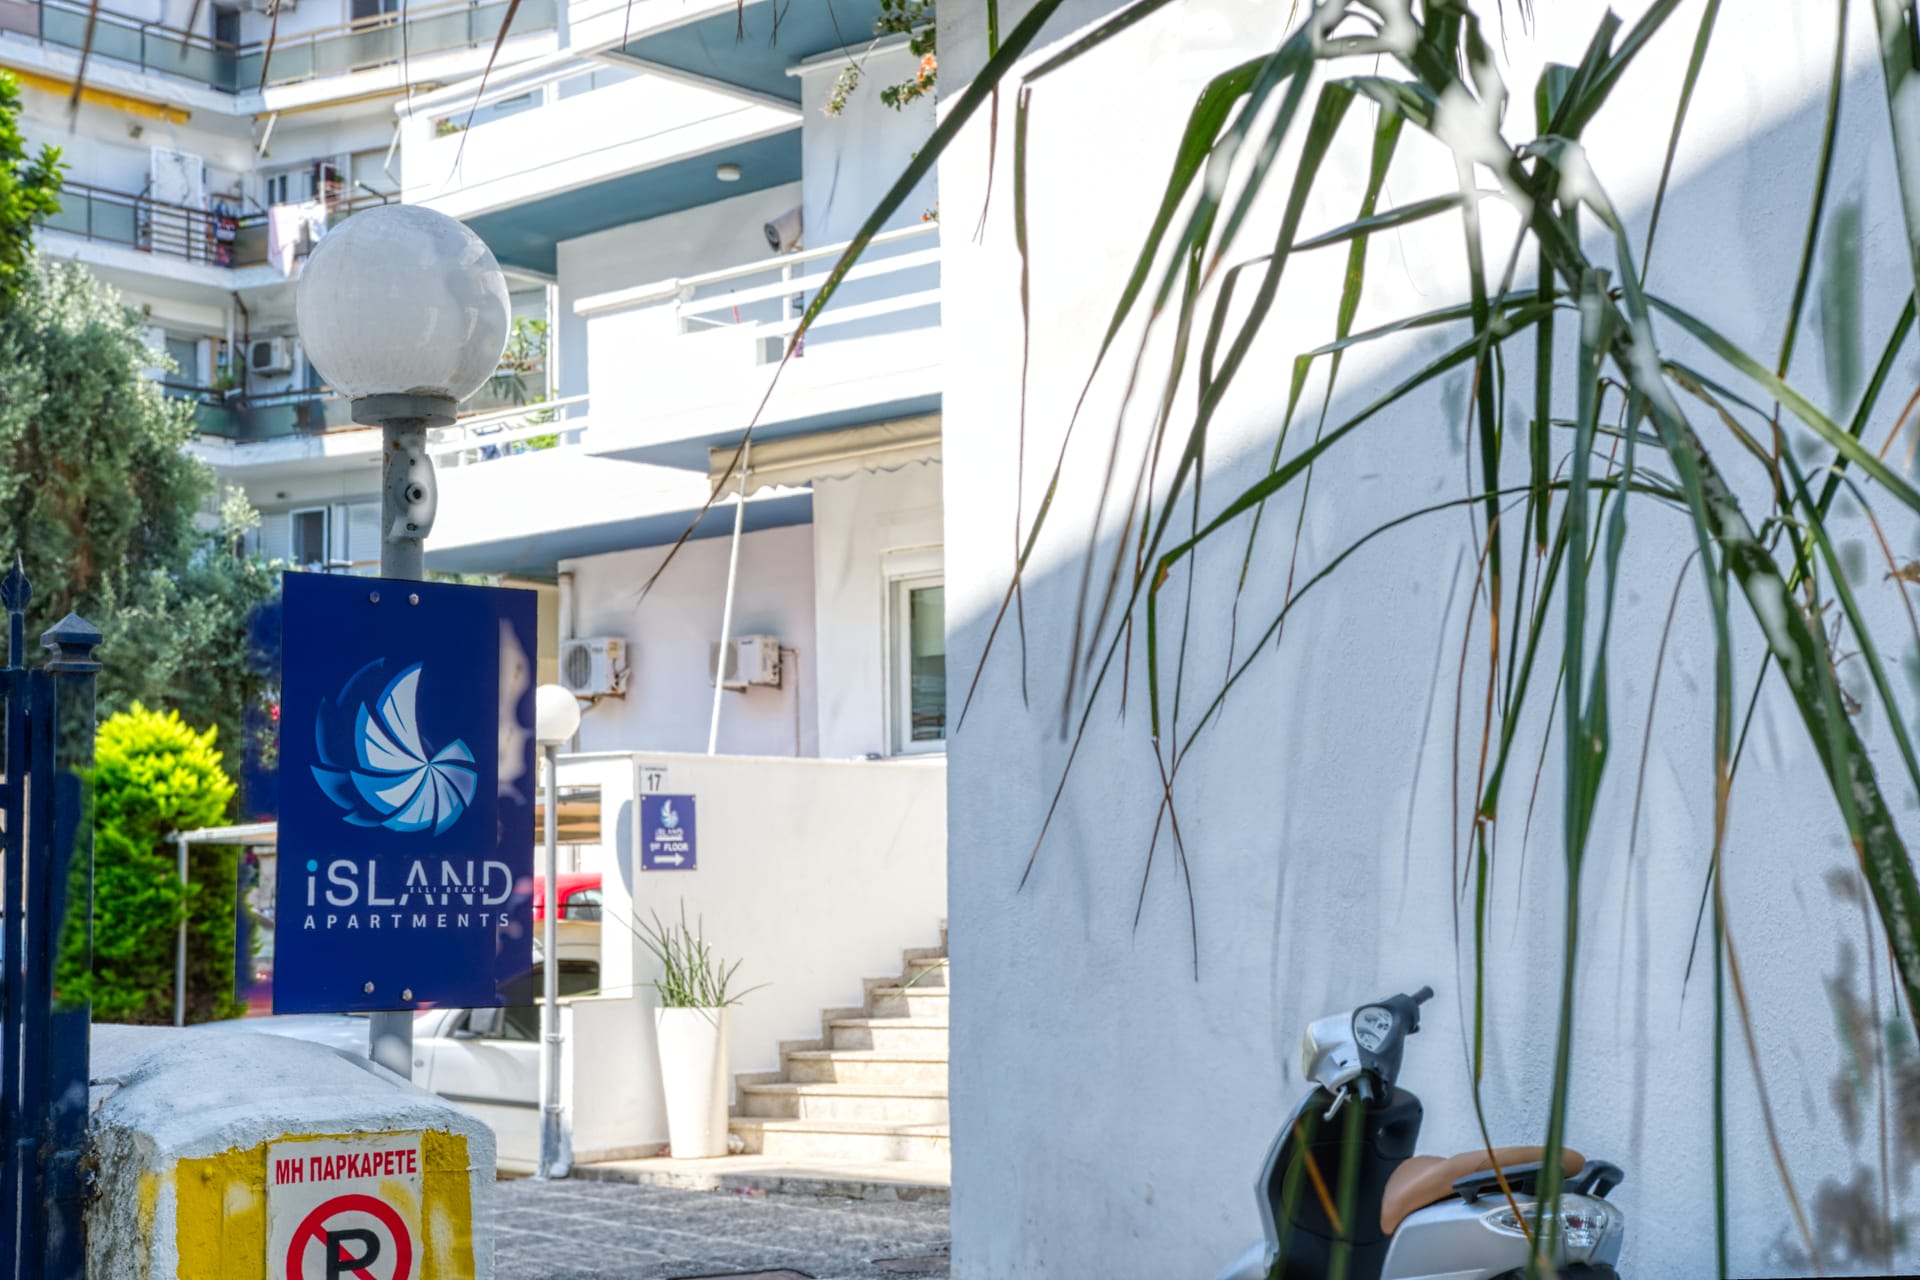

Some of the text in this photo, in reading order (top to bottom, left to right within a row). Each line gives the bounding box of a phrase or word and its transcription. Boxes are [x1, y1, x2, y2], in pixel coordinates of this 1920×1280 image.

[647, 773, 661, 792] 17
[663, 842, 689, 852] FLOOR
[410, 886, 485, 894] ELLI BEACH
[303, 913, 510, 930] APARTMENTS
[275, 1149, 417, 1185] ΜΗ ΠΑΡΚΑΡΕΤΕ
